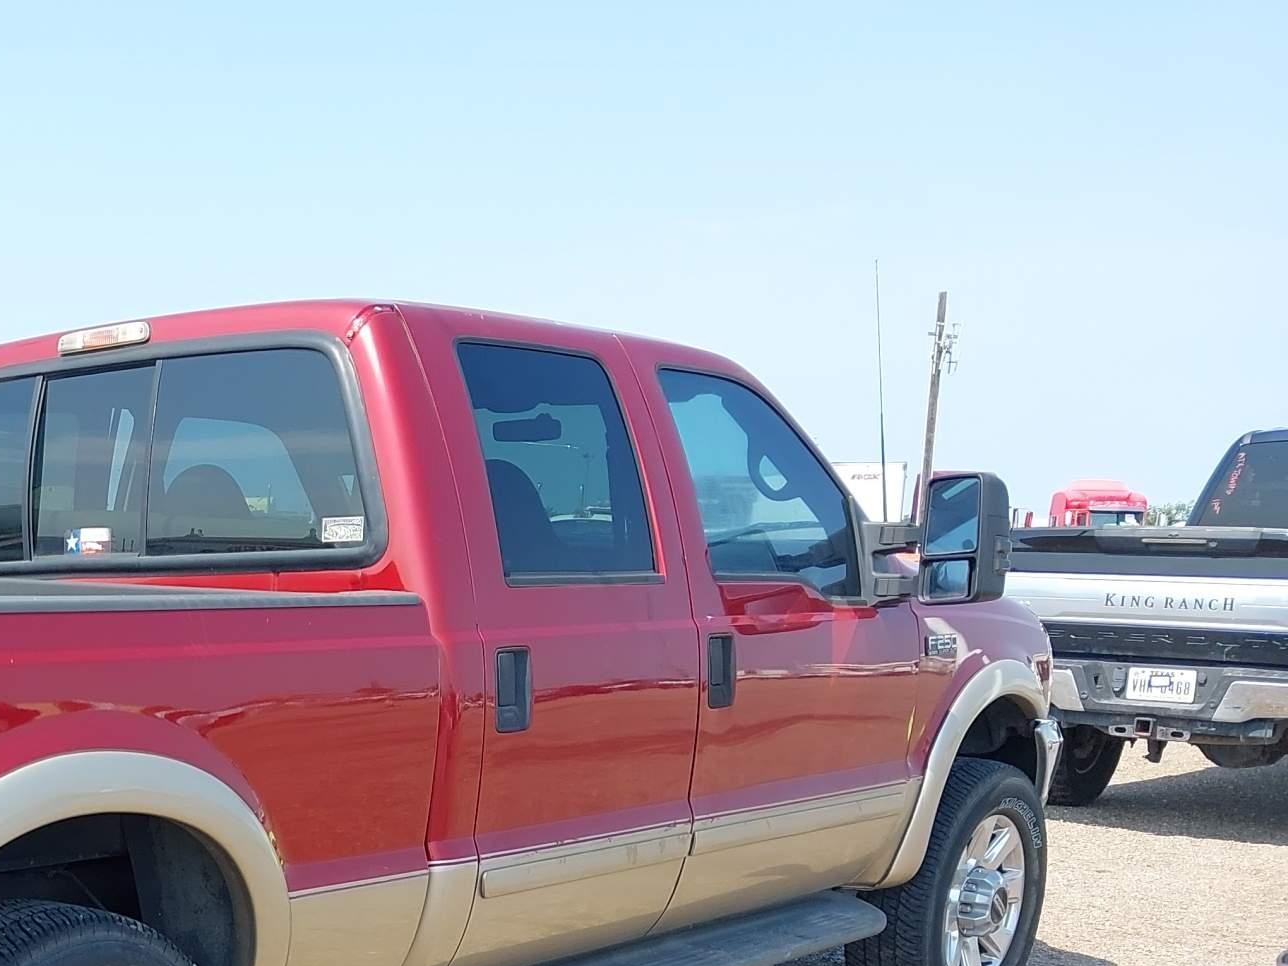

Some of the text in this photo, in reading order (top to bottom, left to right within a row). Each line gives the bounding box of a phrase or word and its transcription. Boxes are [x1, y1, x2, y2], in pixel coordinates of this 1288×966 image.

[1104, 592, 1236, 612] KING RANCH
[998, 797, 1043, 849] MICHELIN
